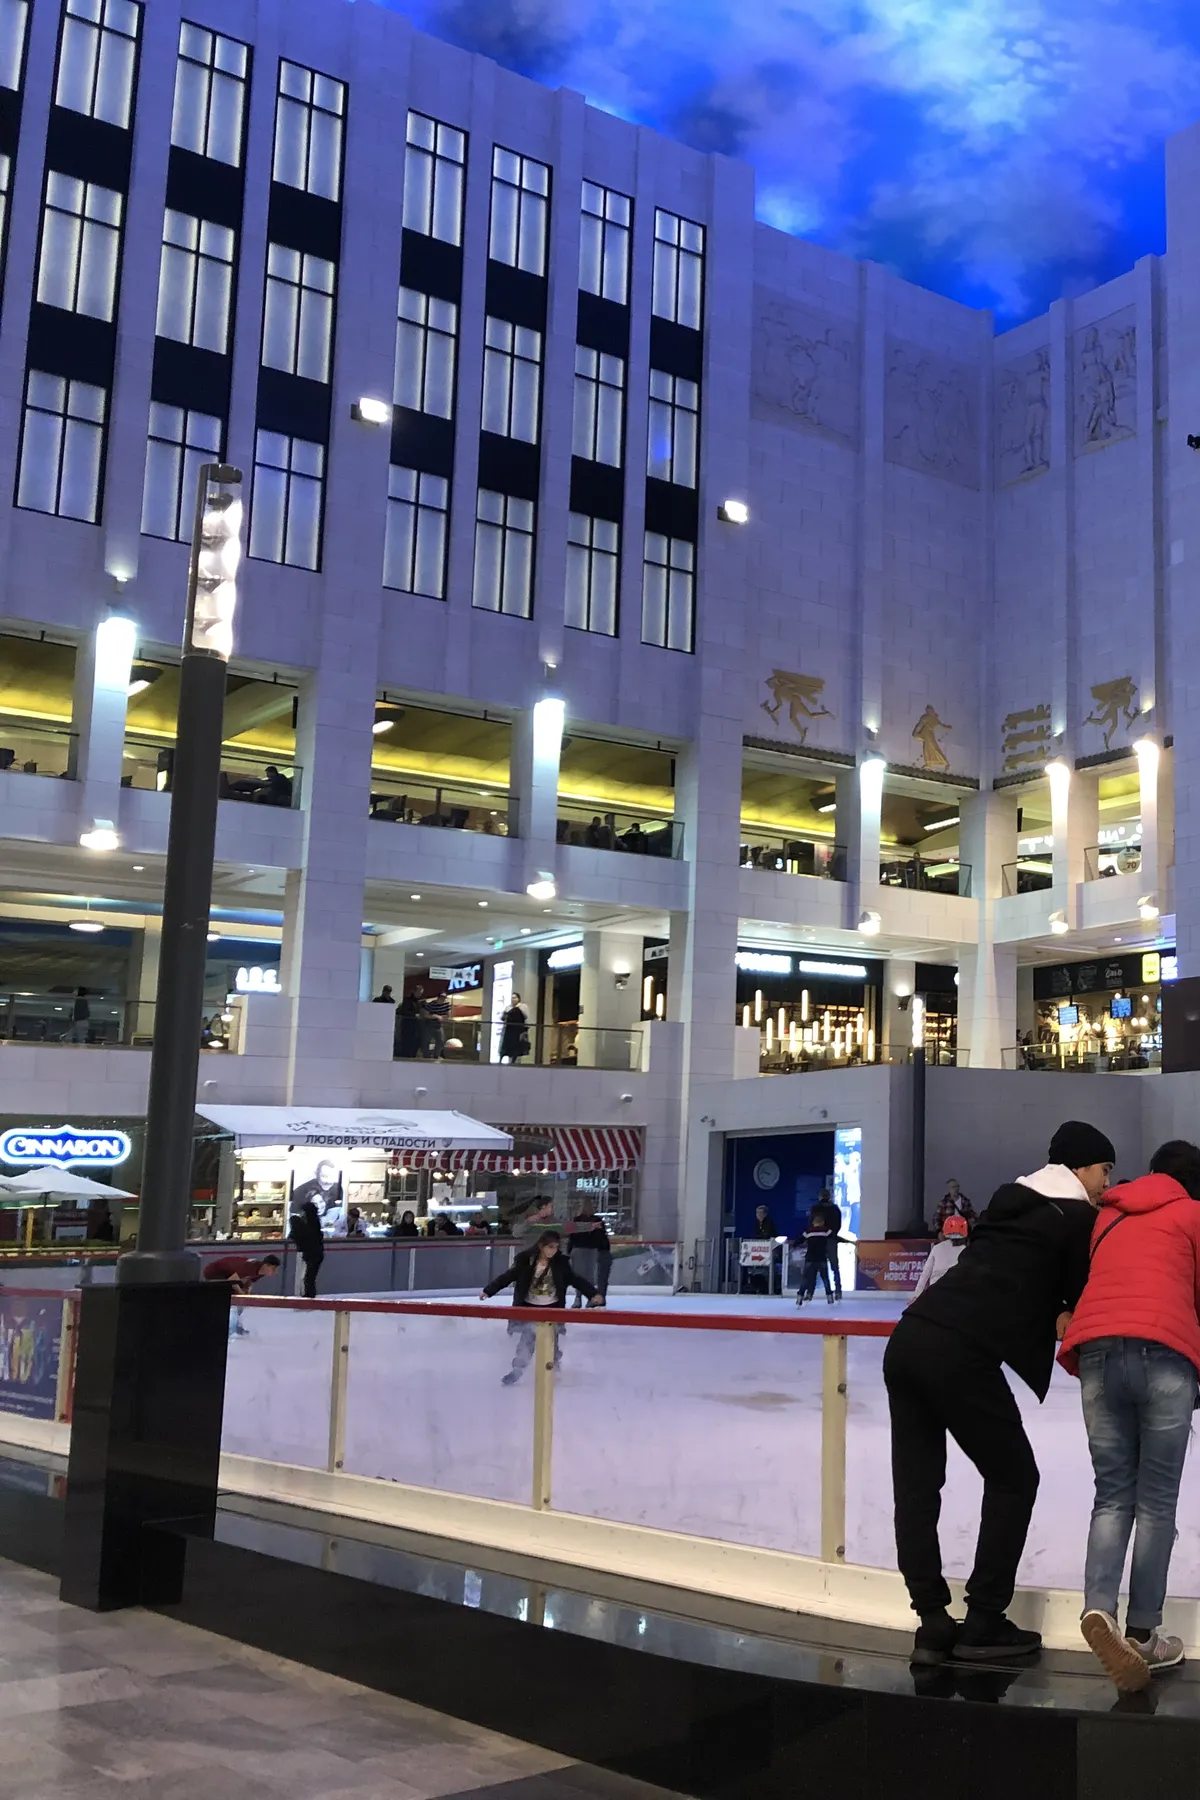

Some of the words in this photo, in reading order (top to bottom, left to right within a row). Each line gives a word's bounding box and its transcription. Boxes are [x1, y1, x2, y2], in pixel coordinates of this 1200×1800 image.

[7, 1136, 121, 1157] CINNABON
[305, 1134, 358, 1146] ЛЮБОВЬ
[361, 1136, 370, 1145] И
[372, 1136, 436, 1149] СЛАДОСТИ
